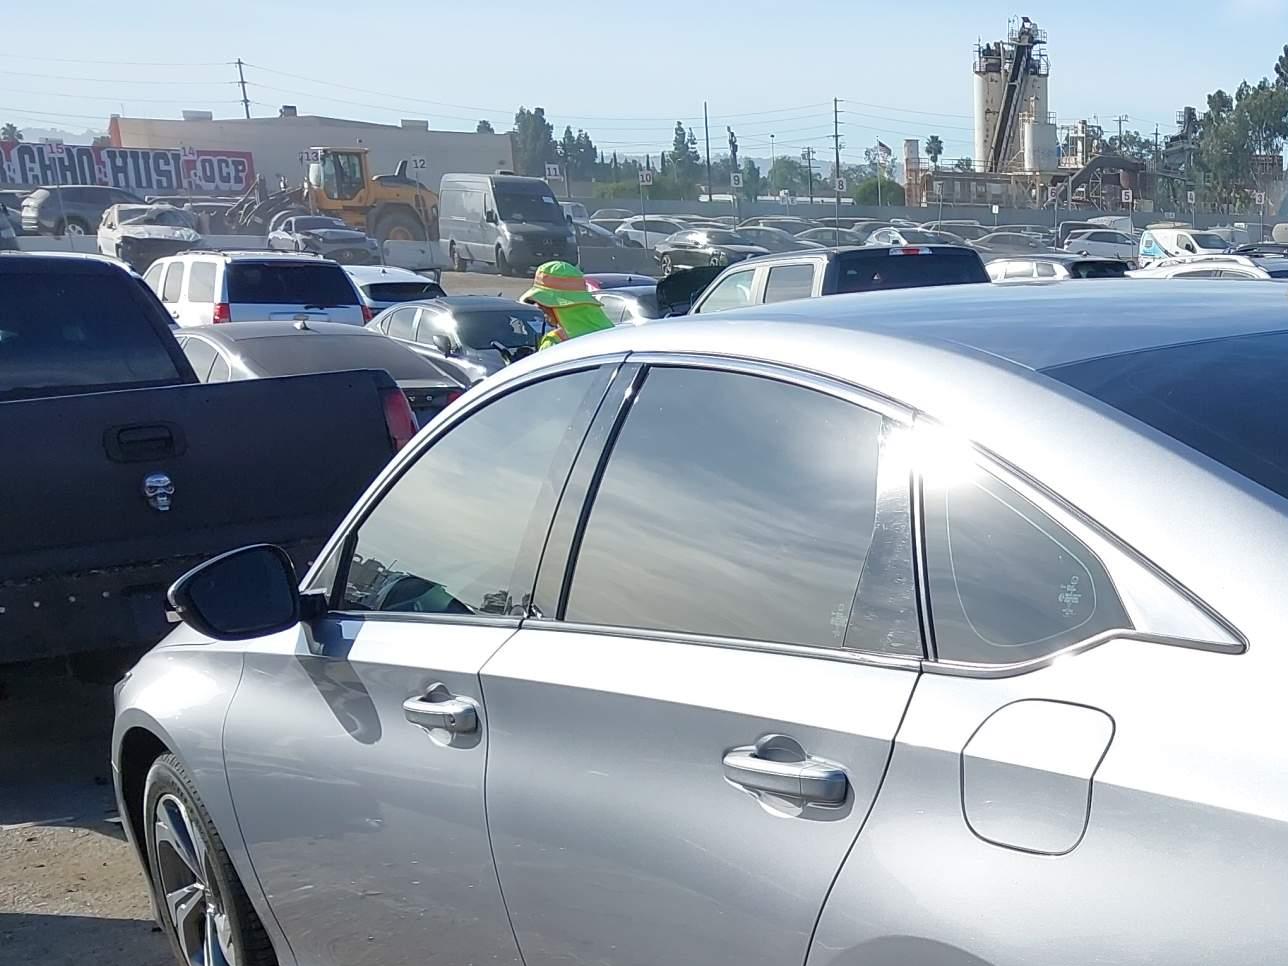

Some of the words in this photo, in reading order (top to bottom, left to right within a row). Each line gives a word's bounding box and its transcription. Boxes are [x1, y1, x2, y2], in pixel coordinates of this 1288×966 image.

[49, 144, 64, 154] 15
[304, 151, 319, 161] 13
[412, 159, 426, 169] 12
[546, 167, 560, 177] 11
[640, 173, 651, 183] 10
[733, 174, 740, 186] 9
[1124, 190, 1130, 200] 5
